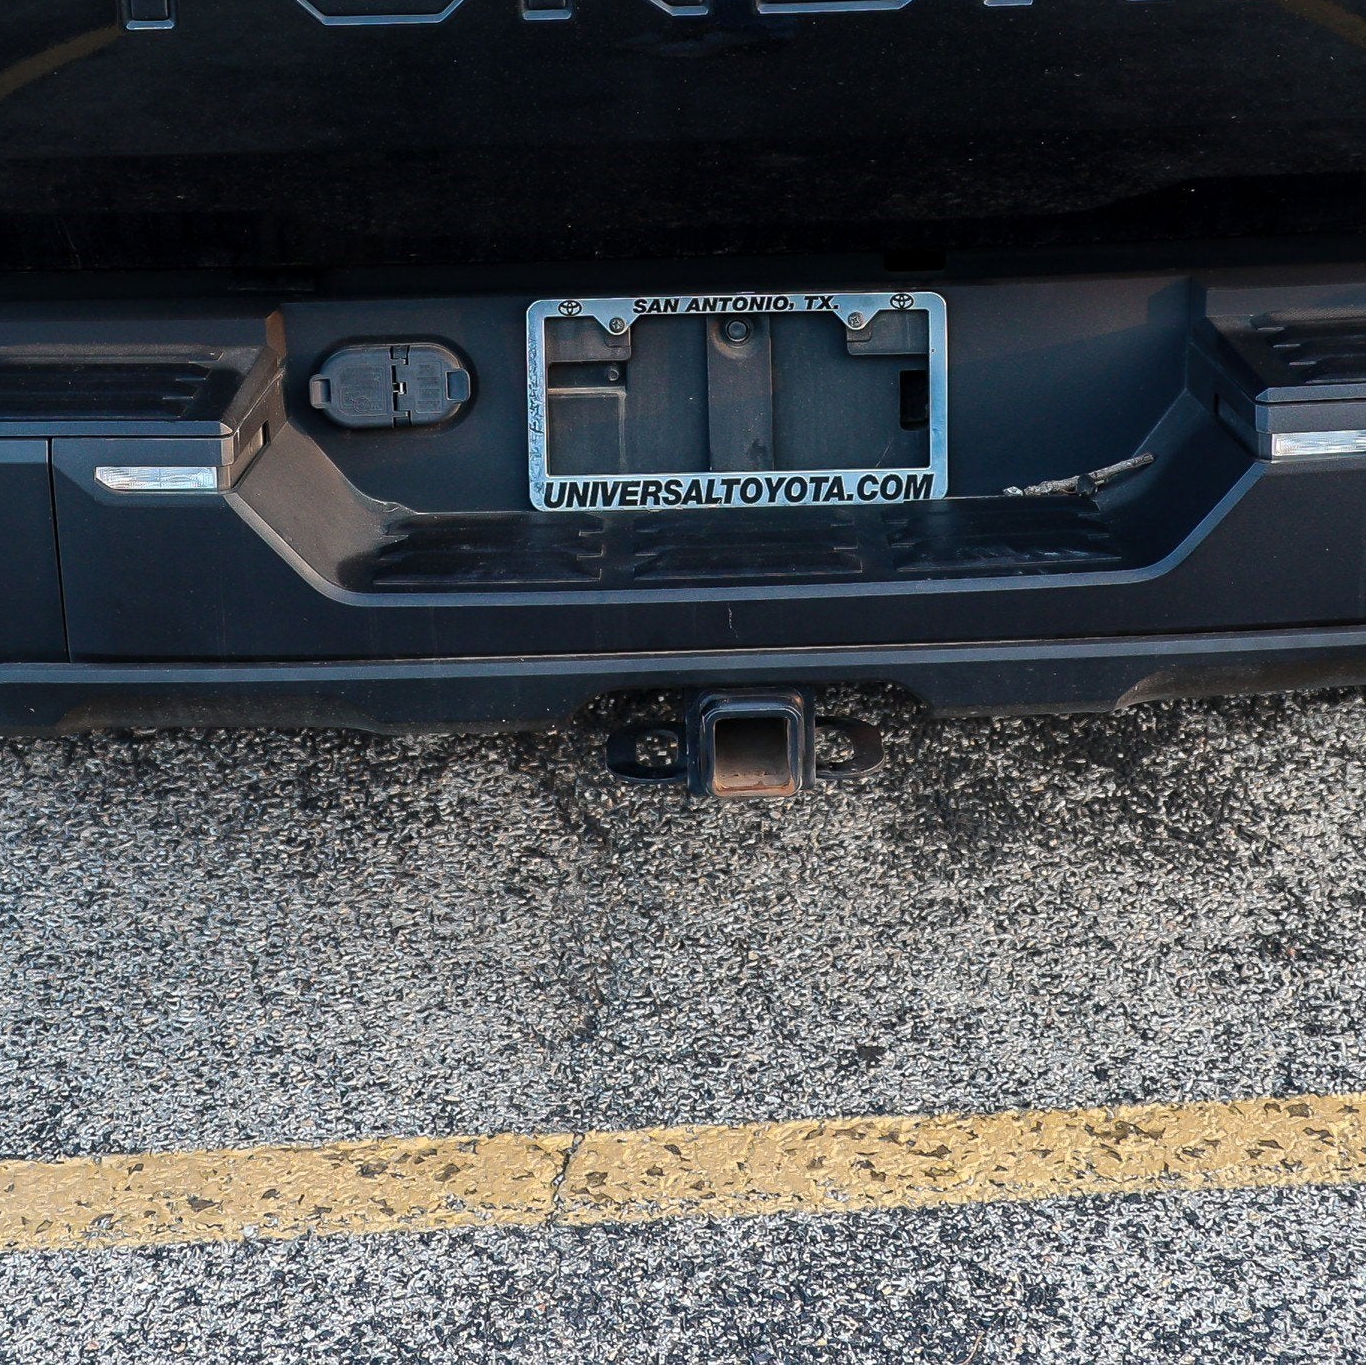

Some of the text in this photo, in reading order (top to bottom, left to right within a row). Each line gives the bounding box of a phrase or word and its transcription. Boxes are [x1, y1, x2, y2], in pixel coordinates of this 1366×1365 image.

[633, 295, 840, 314] SAN ANTONIO, TX.
[543, 474, 935, 508] UNIVERSALTOYOTA.COM
